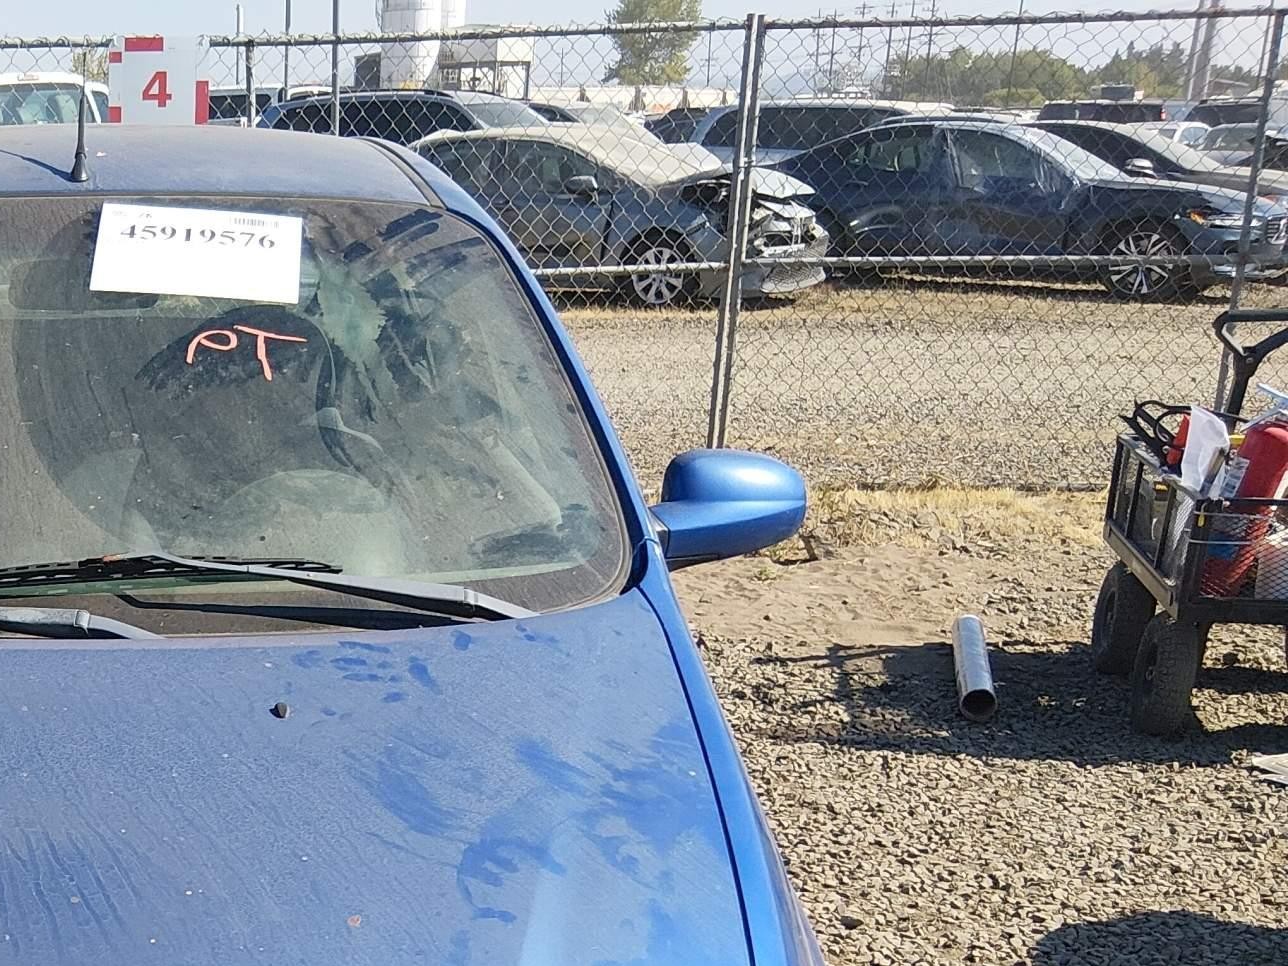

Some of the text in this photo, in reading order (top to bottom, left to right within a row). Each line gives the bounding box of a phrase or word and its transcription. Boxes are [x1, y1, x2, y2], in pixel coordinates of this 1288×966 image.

[142, 71, 172, 108] 4
[120, 224, 275, 248] 45919576
[186, 325, 307, 380] PT
